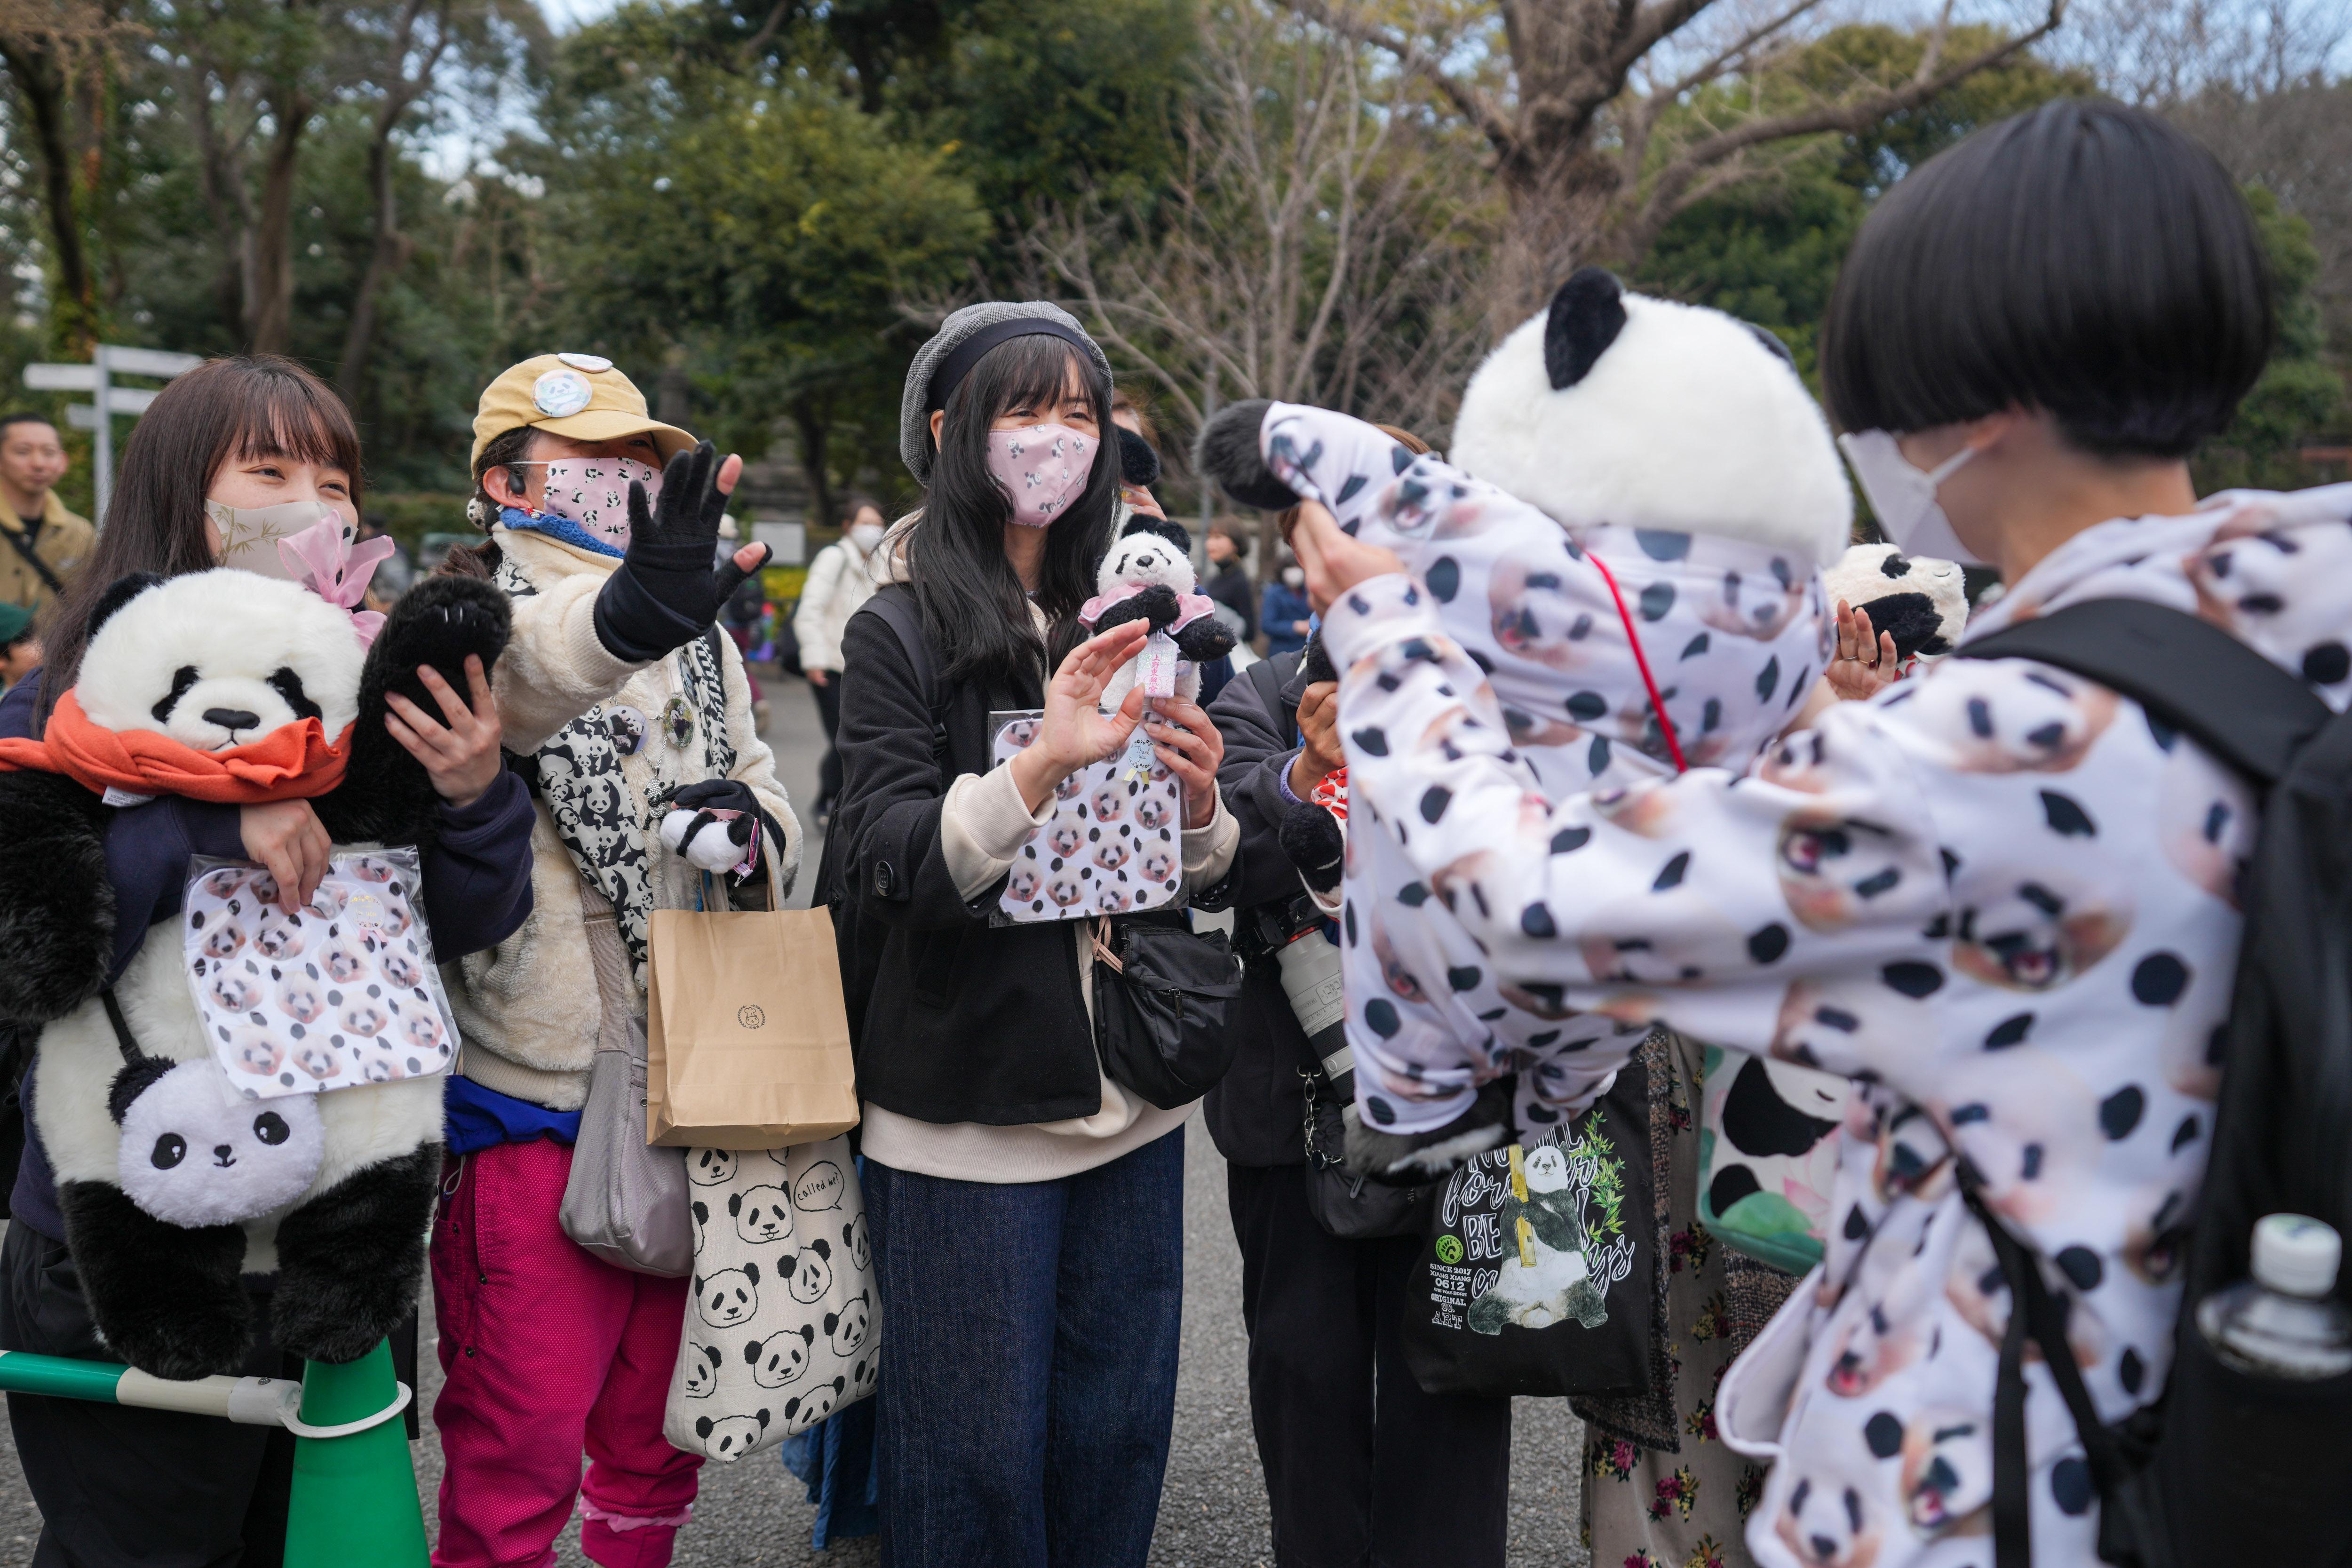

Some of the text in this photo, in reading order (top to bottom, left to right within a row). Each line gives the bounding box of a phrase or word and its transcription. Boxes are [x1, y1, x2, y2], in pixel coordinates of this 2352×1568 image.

[1149, 654, 1160, 693] 上野東照宮
[1135, 745, 1150, 755] Thank
[798, 1172, 840, 1200] called me?
[1430, 1263, 1472, 1275] SINCE 2017
[1430, 1270, 1449, 1280] XIANG
[1435, 1278, 1465, 1291] 0612
[1431, 1293, 1467, 1306] ORIGINAL
[1441, 1302, 1455, 1313] CO.
[1431, 1311, 1462, 1329] ART
